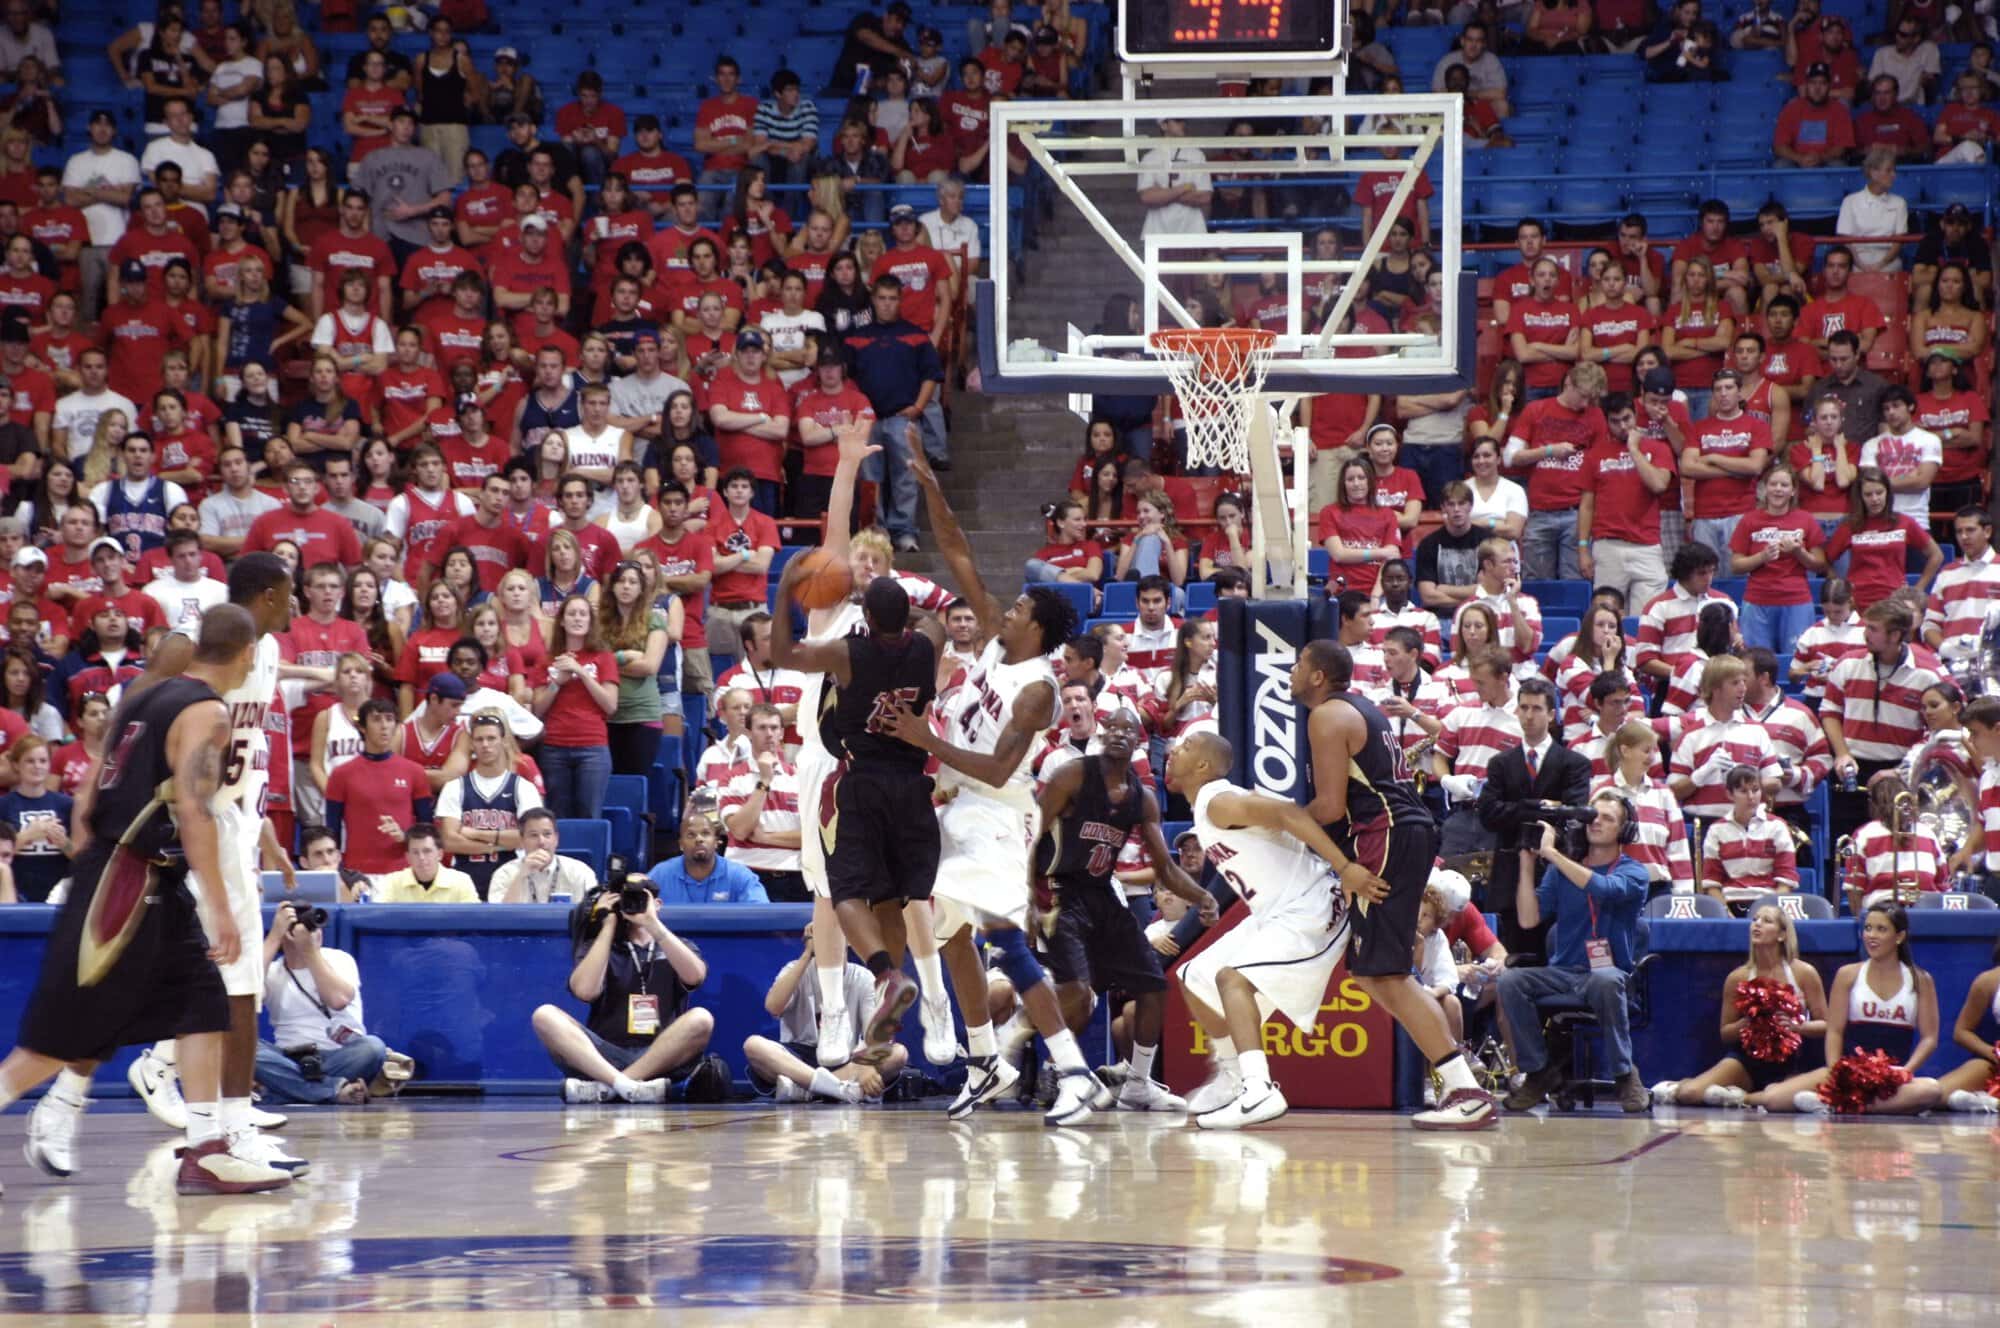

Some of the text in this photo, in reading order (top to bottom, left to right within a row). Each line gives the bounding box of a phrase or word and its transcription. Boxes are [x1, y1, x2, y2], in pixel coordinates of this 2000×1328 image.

[571, 452, 619, 468] ARIZONA
[1225, 869, 1257, 901] 2
[1664, 896, 1702, 920] A
[1777, 896, 1809, 920] A
[1942, 895, 1969, 911] A
[1189, 1020, 1369, 1058] FRGO
